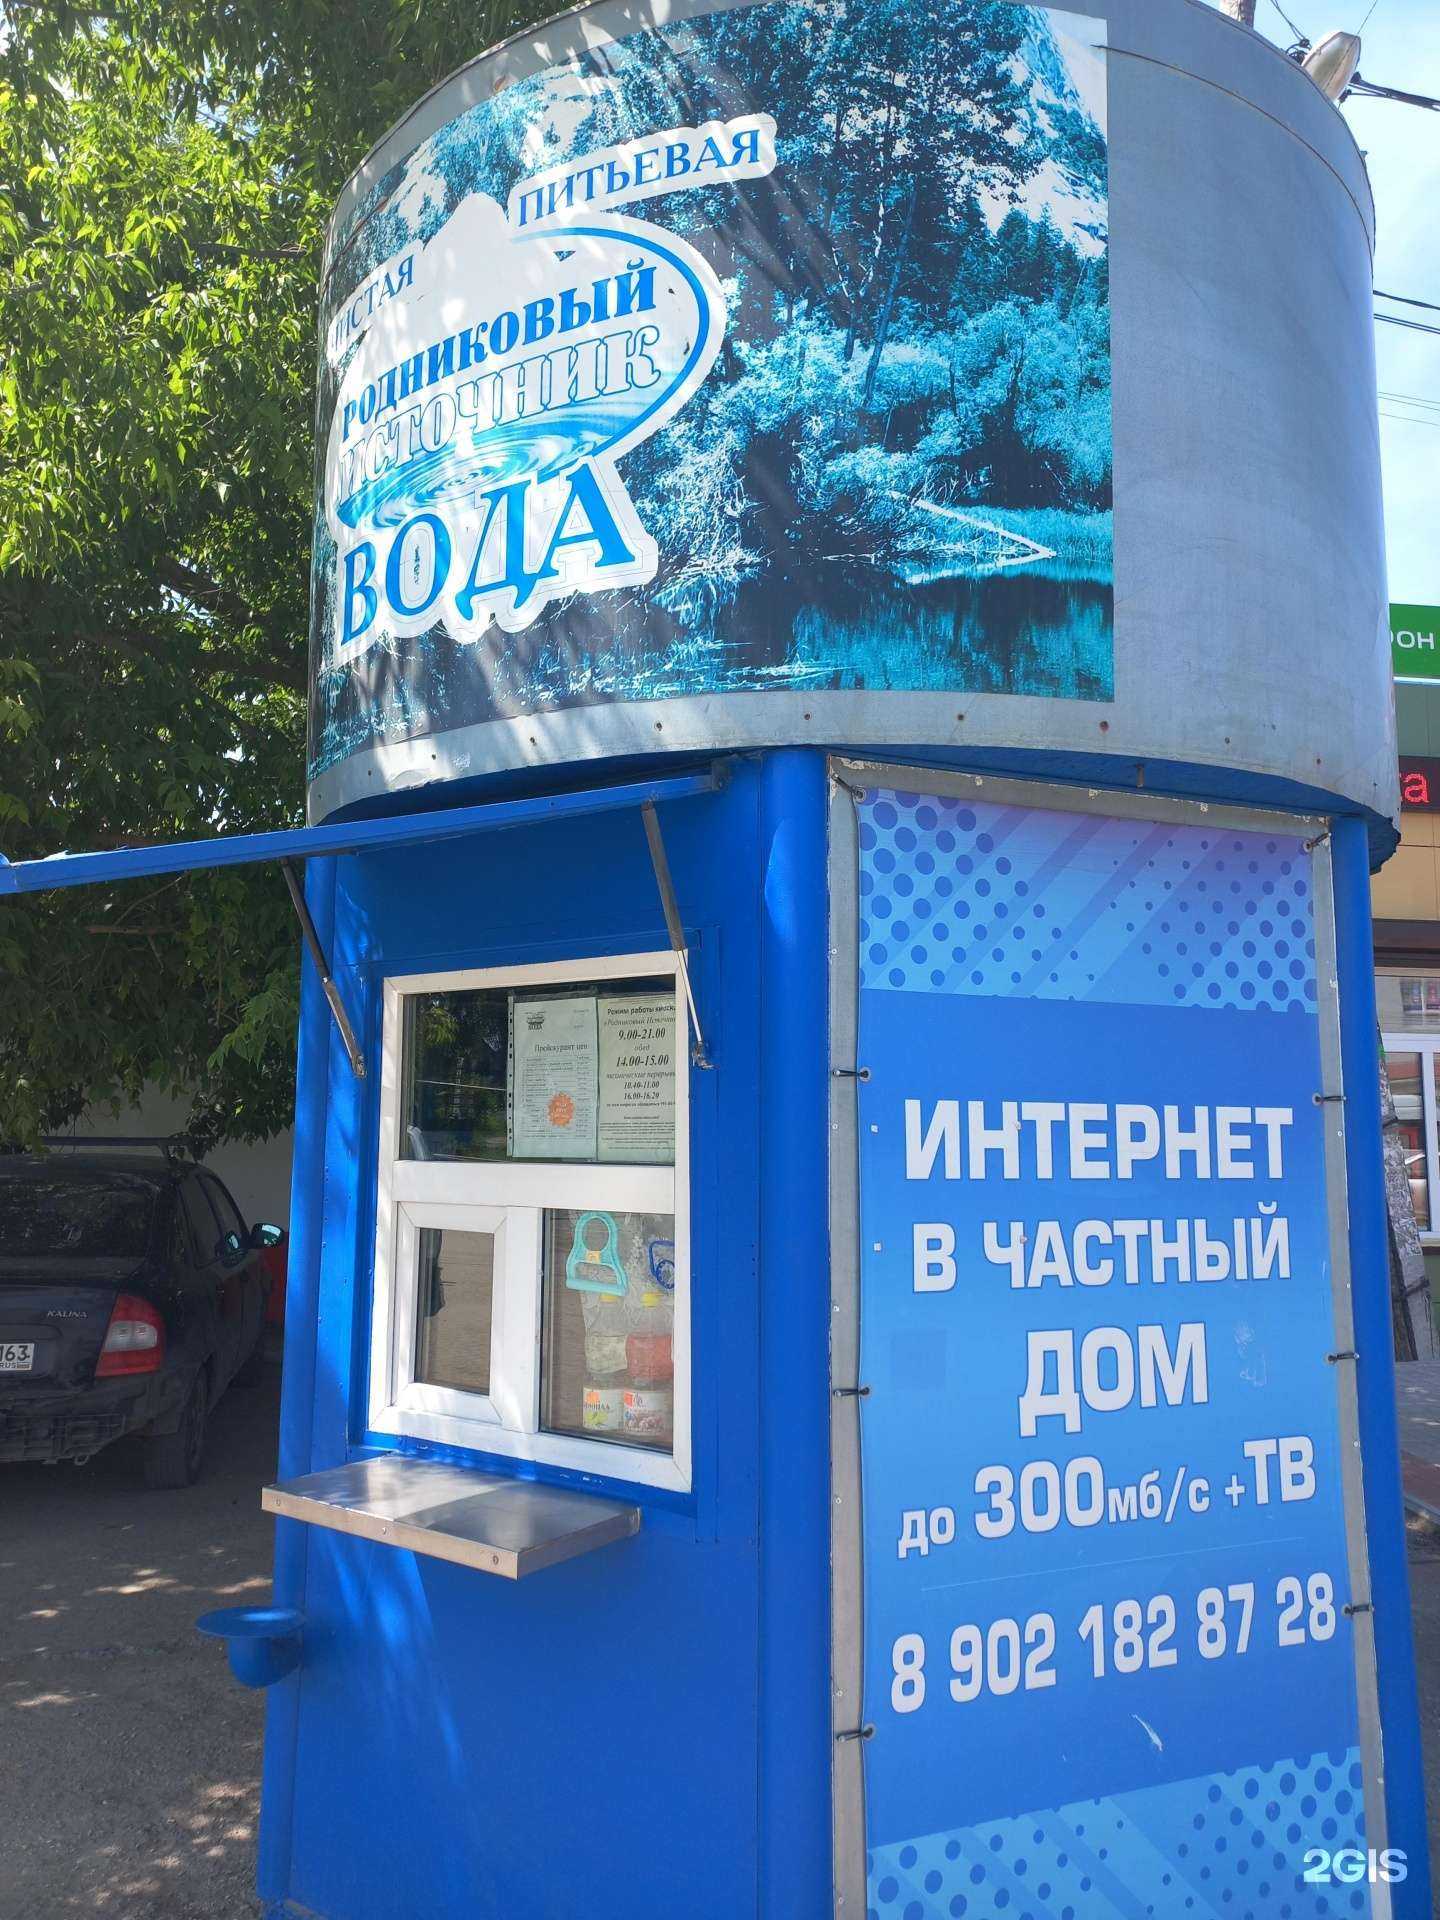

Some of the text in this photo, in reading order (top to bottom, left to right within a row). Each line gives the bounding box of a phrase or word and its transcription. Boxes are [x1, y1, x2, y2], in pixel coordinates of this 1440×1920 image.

[518, 129, 761, 227] ПИТЬЕВАЯ
[344, 258, 657, 444] РОДНИКОВЫЙ
[337, 325, 662, 500] ИСТОЧНИК
[340, 463, 635, 648] ВОДА
[1390, 629, 1435, 650] ОН
[618, 1028, 666, 1041] 9.00-21.00
[630, 1006, 654, 1016] работы
[616, 1055, 669, 1067] 14.00-15.00
[904, 1099, 1294, 1180] ИНТЕРНЕТ
[912, 1200, 1291, 1294] В ЧАСТНЫЙ
[47, 1309, 88, 1319] KALINA
[1018, 1322, 1209, 1438] ДОМ
[897, 1506, 955, 1559] до
[890, 1571, 1336, 1714] 8 902 182 87 28
